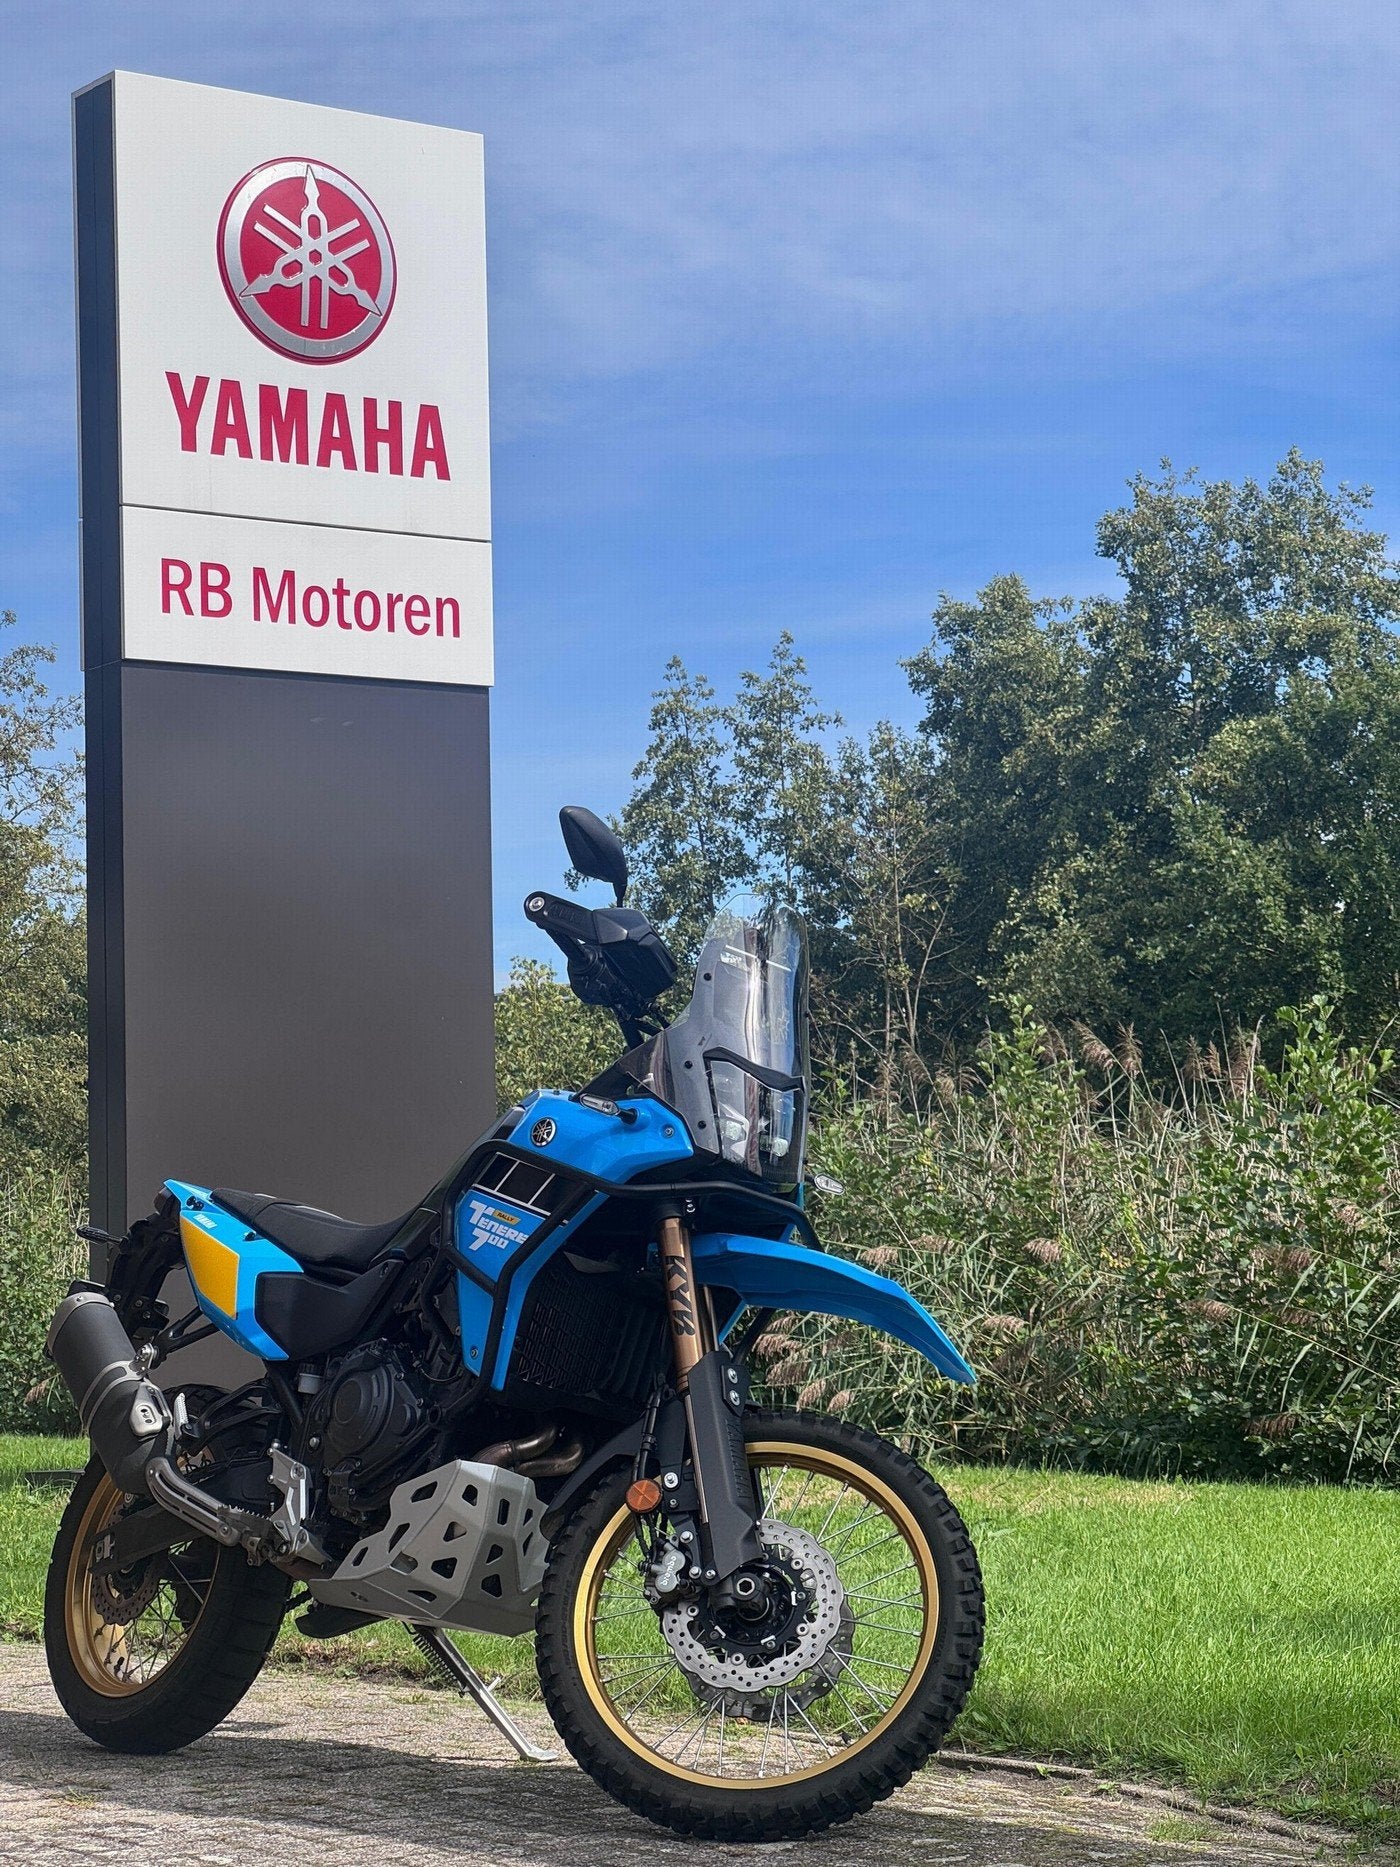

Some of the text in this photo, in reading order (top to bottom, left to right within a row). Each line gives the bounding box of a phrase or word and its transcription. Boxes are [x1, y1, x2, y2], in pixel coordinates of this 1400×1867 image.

[165, 371, 451, 481] YAMAHA
[161, 558, 460, 637] RB Motoren
[469, 1227, 509, 1251] 700
[665, 1256, 695, 1335] KYB
[660, 1556, 677, 1586] brembo
